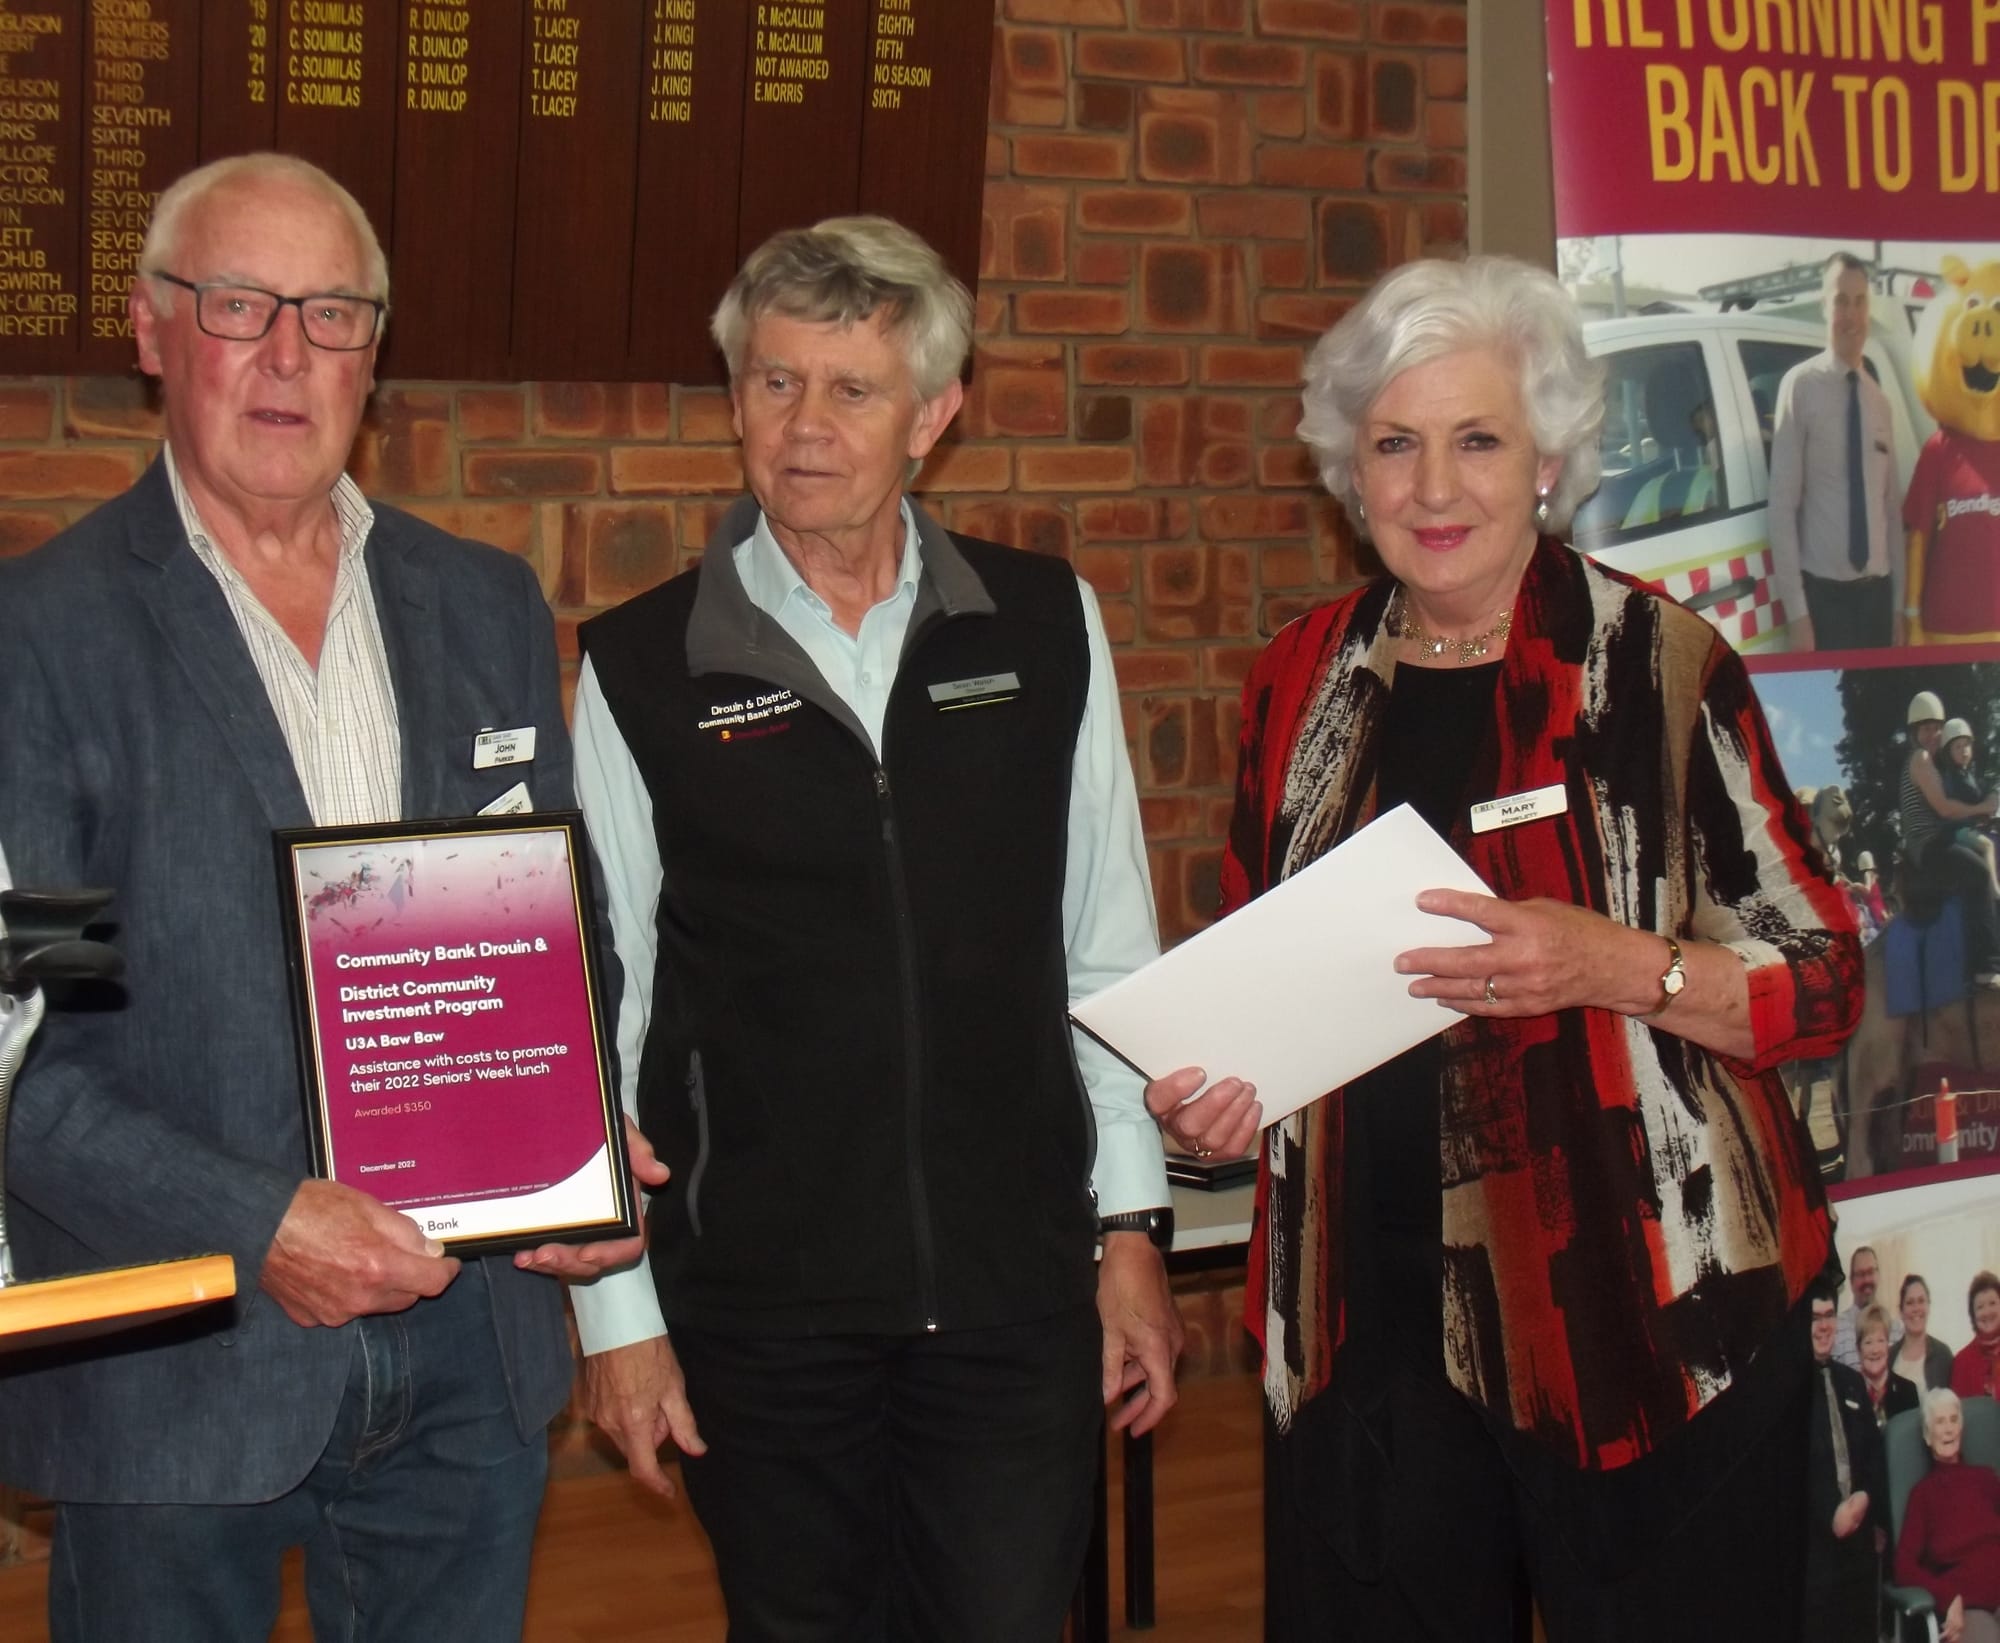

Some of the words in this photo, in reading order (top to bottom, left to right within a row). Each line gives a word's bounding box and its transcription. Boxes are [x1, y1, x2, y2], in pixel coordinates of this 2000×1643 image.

[304, 4, 363, 26] SOUMILAS
[410, 8, 420, 29] R.
[423, 10, 469, 33] DUNLOP
[758, 5, 768, 26] R.
[770, 7, 824, 29] McCALLUM
[877, 14, 915, 37] EIGHTH
[534, 16, 542, 37] T.
[545, 18, 579, 39] LACEY
[653, 24, 662, 43] J.
[665, 24, 694, 45] KINGI
[289, 28, 299, 49] C.
[303, 29, 362, 53] SOUMILAS
[408, 36, 419, 57] R.
[422, 36, 468, 59] DUNLOP
[757, 31, 766, 51] R.
[769, 32, 823, 54] McCALLUM
[876, 39, 903, 60] FIFTH
[533, 42, 541, 63] T.
[543, 44, 578, 65] LACEY
[652, 50, 661, 70] J.
[663, 51, 692, 71] KINGI
[95, 60, 144, 81] THIRD
[289, 55, 300, 77] C.
[302, 56, 361, 81] SOUMILAS
[408, 62, 418, 83] R.
[421, 63, 467, 85] DUNLOP
[755, 57, 777, 77] NOT
[779, 59, 829, 80] AWARDED
[874, 65, 890, 84] NO
[891, 67, 931, 88] SEASON
[532, 69, 540, 90] T.
[542, 70, 578, 91] LACEY
[651, 76, 660, 96] J.
[662, 76, 691, 96] KINGI
[95, 82, 144, 104] THIRD
[287, 82, 299, 103] C.
[301, 83, 360, 107] SOUMILAS
[407, 88, 418, 109] R.
[420, 90, 466, 111] DUNLOP
[872, 89, 901, 109] SIXTH
[93, 105, 171, 126] SEVENTH
[531, 95, 539, 116] T.
[542, 96, 576, 117] LACEY
[650, 101, 659, 120] J.
[661, 102, 690, 121] KINGI
[92, 128, 140, 146] SIXTH
[1645, 64, 1821, 188] BACK
[1832, 74, 1912, 193] TO
[94, 149, 146, 168] THIRD
[92, 169, 139, 188] SIXTH
[698, 714, 746, 729] Community
[774, 699, 802, 715] Branch
[711, 702, 744, 716] Drouin
[745, 700, 754, 710] &
[756, 689, 792, 707] District
[495, 744, 516, 753] JOHN
[1502, 802, 1536, 816] MARY
[336, 948, 430, 969] Community
[435, 943, 476, 961] Bank
[479, 939, 531, 957] Drouin
[534, 937, 548, 951] &
[340, 983, 400, 1002] District
[402, 975, 496, 994] Community
[342, 1002, 432, 1023] Investment
[434, 998, 503, 1016] Program
[345, 1036, 376, 1050] U3A
[380, 1033, 411, 1047] Baw
[414, 1031, 445, 1044] Baw
[349, 1059, 421, 1076] Assistance
[424, 1054, 453, 1068] with
[456, 1051, 492, 1066] costs
[495, 1048, 509, 1061] to
[512, 1043, 568, 1063] promote
[350, 1080, 381, 1094] their
[384, 1075, 420, 1091] 2022
[475, 1065, 513, 1081] Week
[515, 1060, 550, 1076] lunch
[354, 1103, 401, 1119] Awarded
[403, 1100, 432, 1113] $350
[359, 1163, 396, 1174] December
[397, 1160, 416, 1170] 2022
[427, 1217, 459, 1232] Bank
